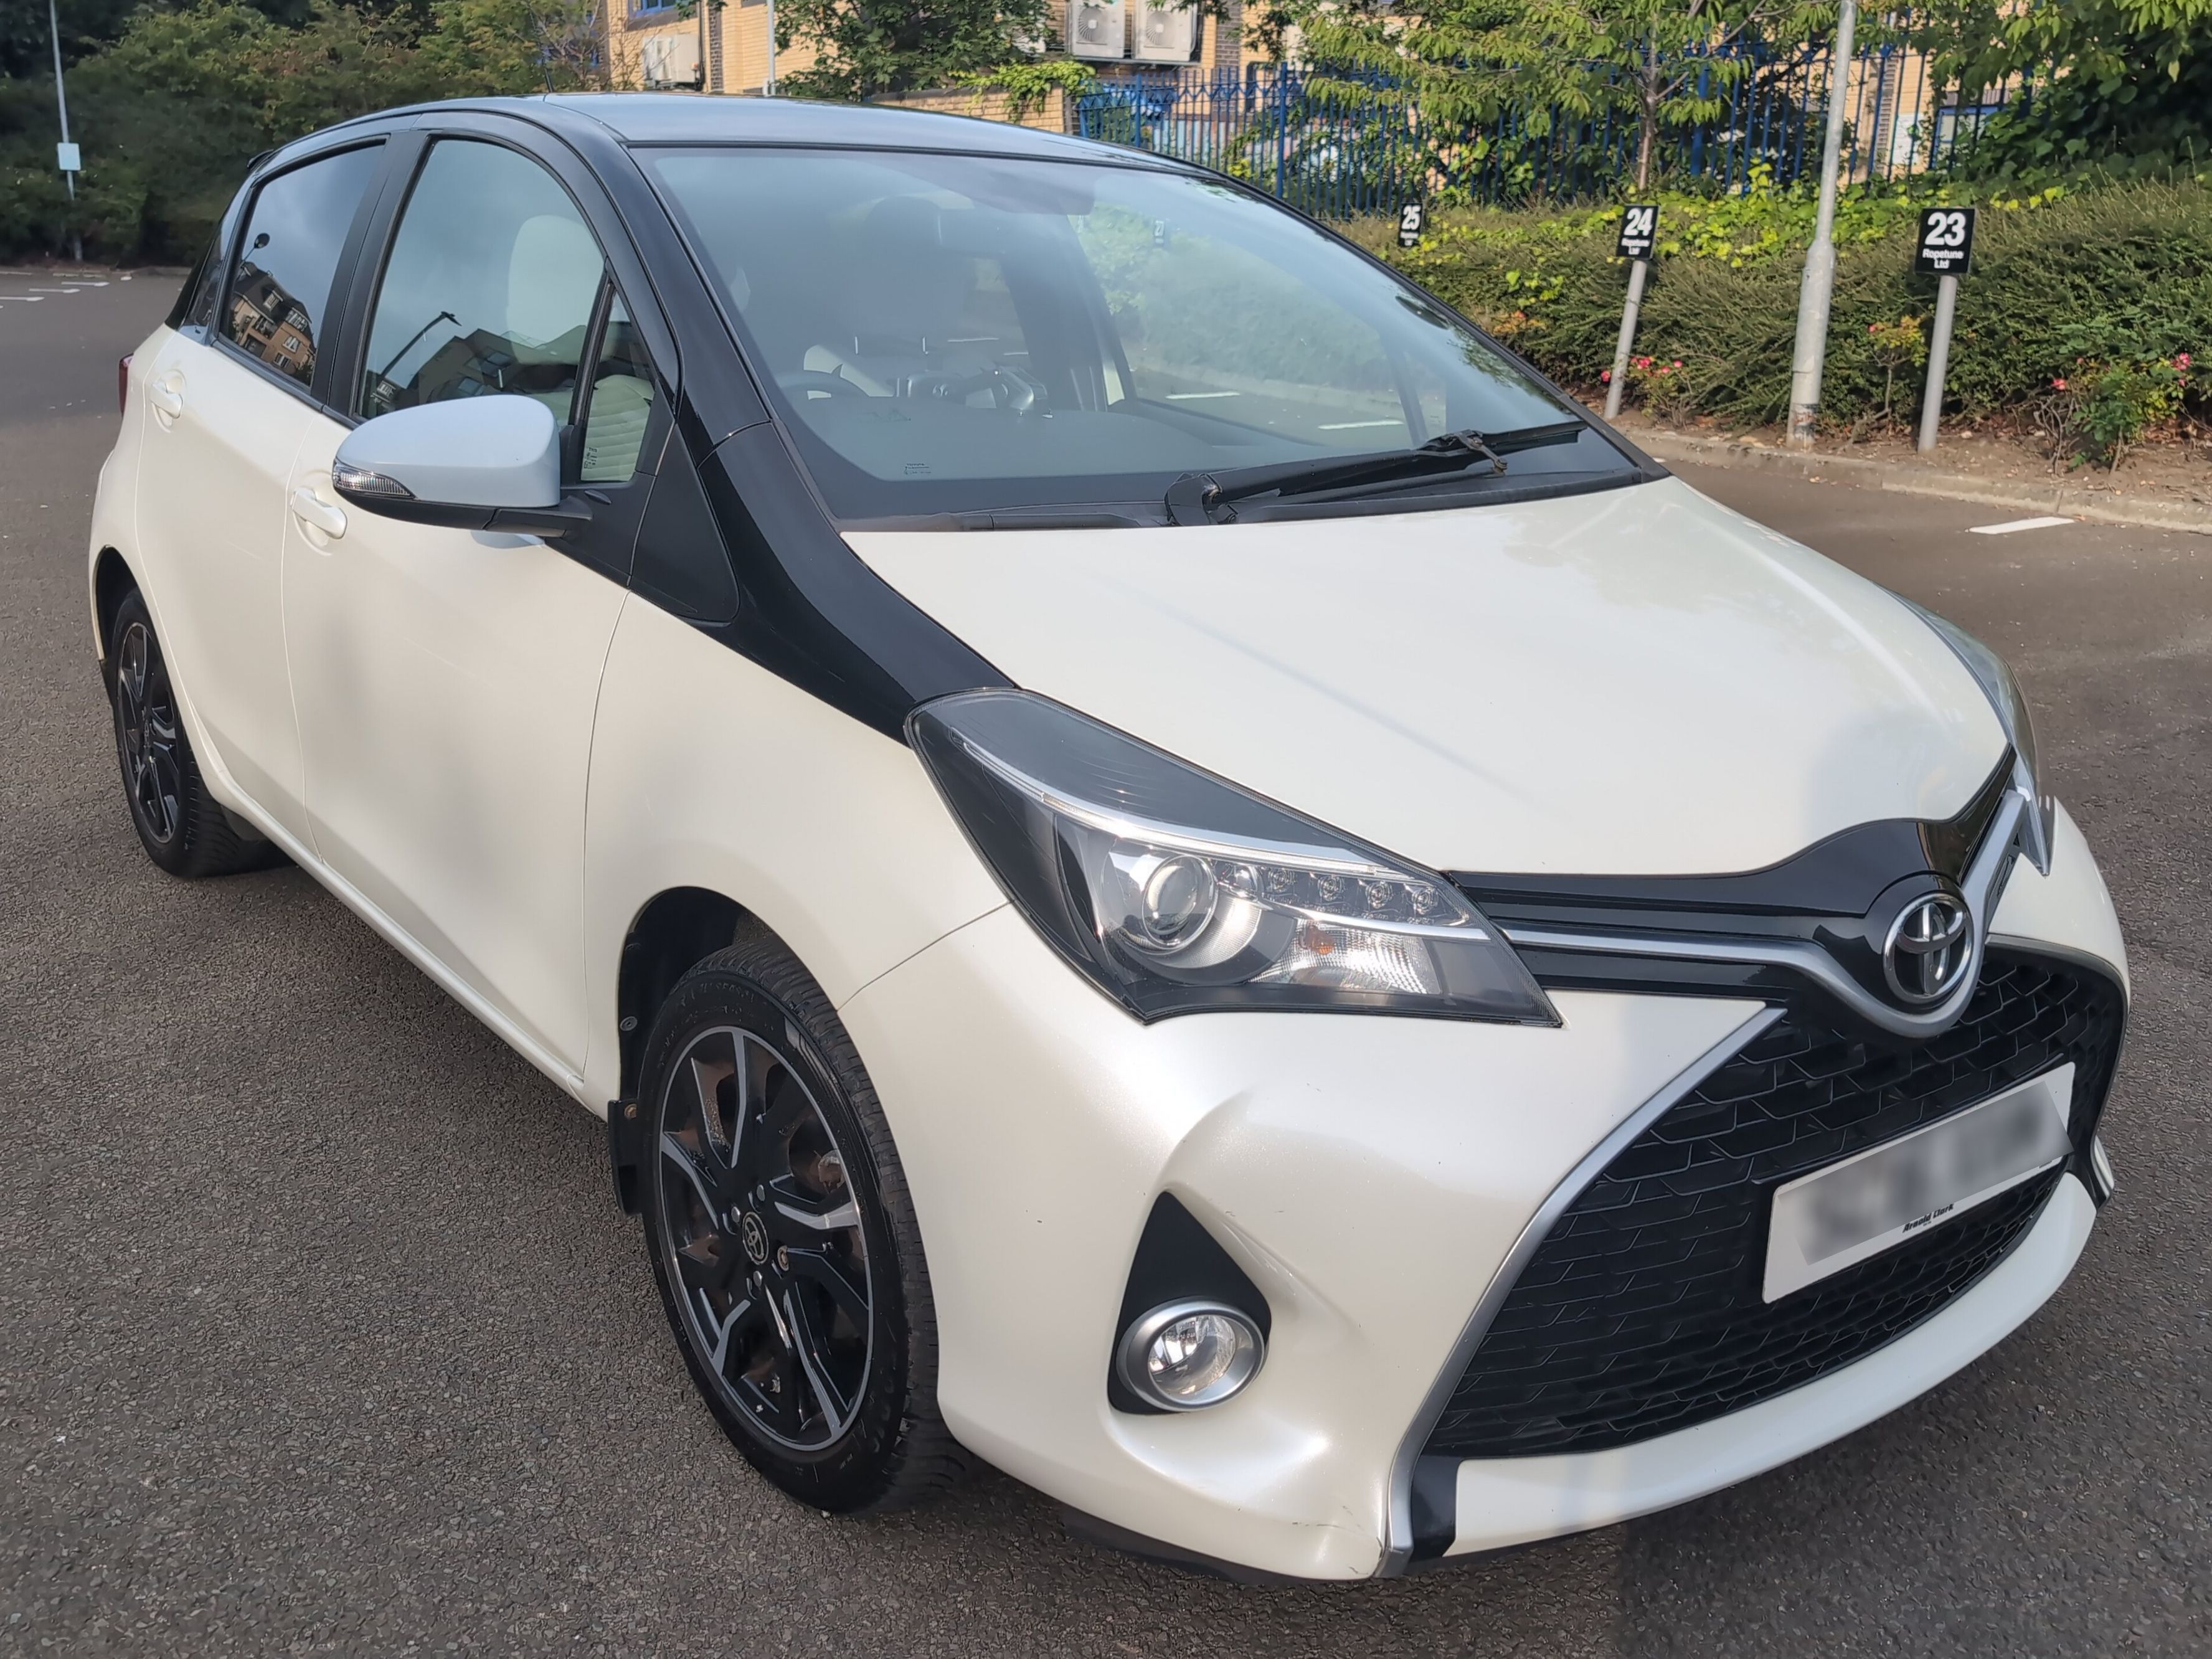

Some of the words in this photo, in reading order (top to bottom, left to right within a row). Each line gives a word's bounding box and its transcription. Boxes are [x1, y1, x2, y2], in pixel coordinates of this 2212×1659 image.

[1401, 205, 1421, 230] 25
[1624, 208, 1653, 236] 24
[1924, 212, 1966, 247] 23
[1902, 1212, 1932, 1234] Arnold
[1932, 1203, 1955, 1219] Clark
